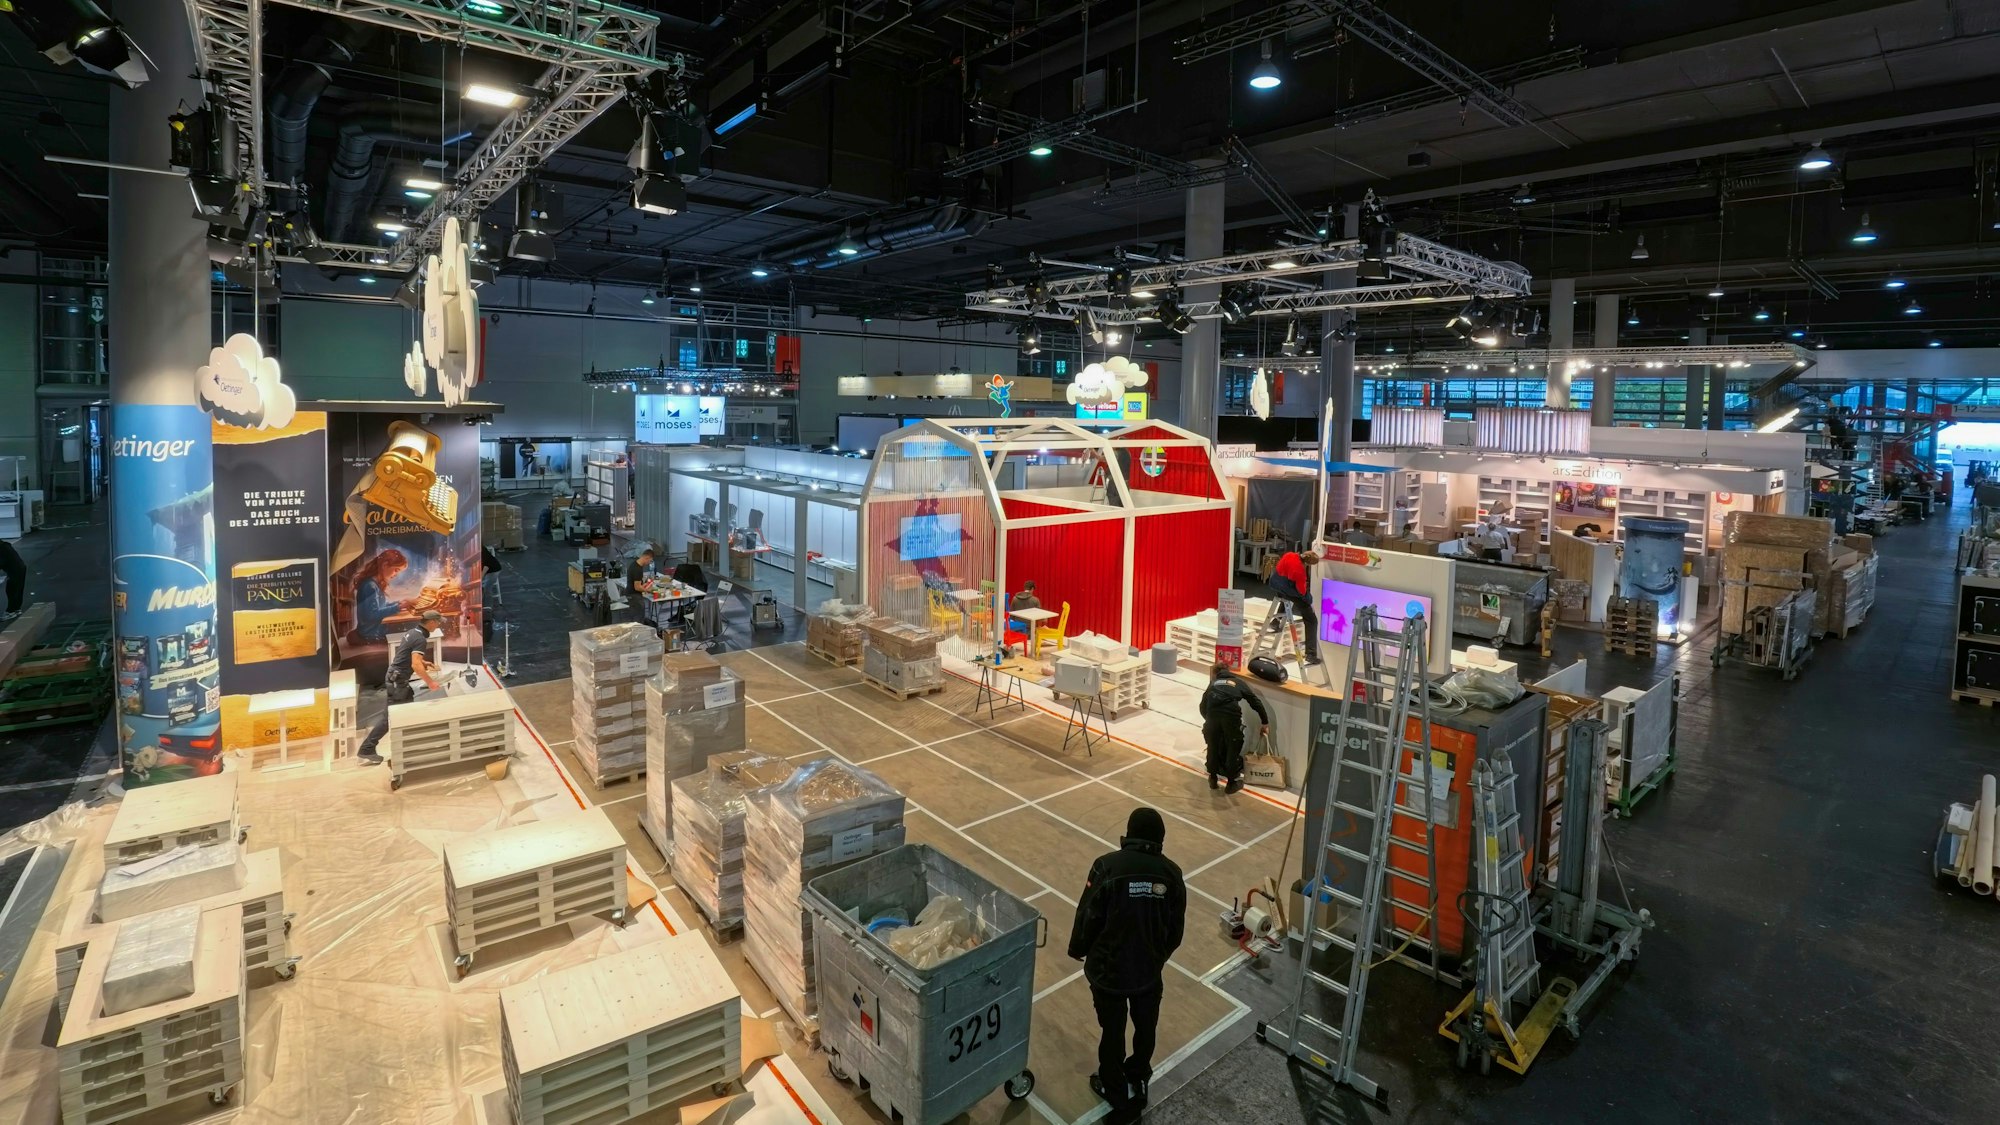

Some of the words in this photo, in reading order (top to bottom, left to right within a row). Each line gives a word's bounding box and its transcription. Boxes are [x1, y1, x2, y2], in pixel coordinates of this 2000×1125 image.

[110, 434, 195, 463] etinger
[243, 492, 260, 500] DIE
[264, 490, 305, 499] TRIBUTE
[245, 499, 264, 507] VON
[269, 498, 305, 507] PANEM.
[250, 511, 270, 519] DAS
[274, 509, 300, 517] BUCH
[229, 519, 249, 528] DES
[253, 517, 291, 526] JAHRES
[295, 516, 320, 524] 2025
[247, 587, 303, 603] PANEM
[949, 1003, 1001, 1062] 329
